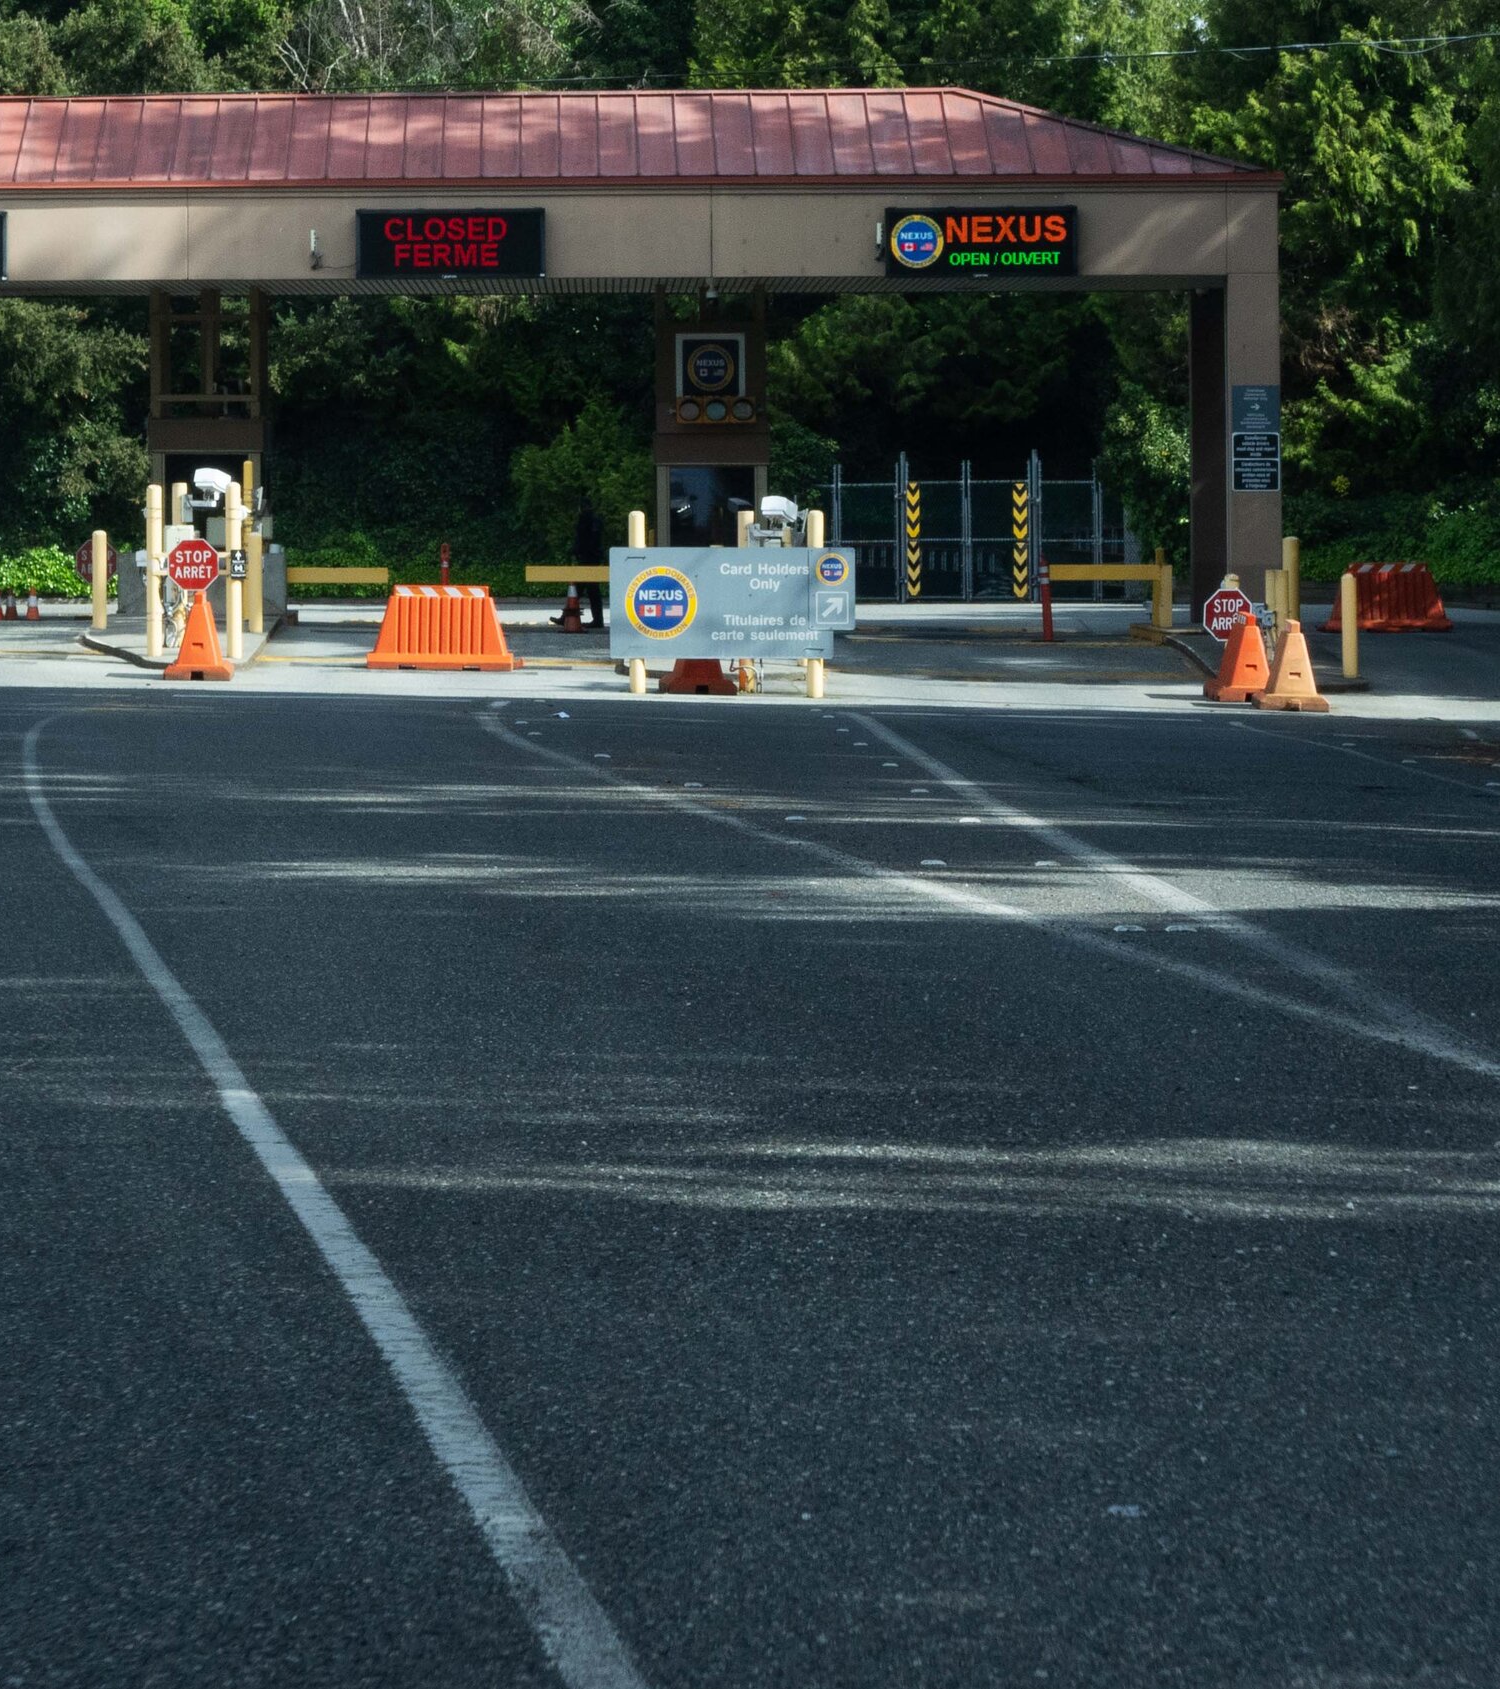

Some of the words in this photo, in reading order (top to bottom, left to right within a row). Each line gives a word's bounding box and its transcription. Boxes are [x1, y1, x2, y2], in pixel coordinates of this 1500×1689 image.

[384, 217, 508, 241] CLOSED
[945, 215, 1067, 243] NEXUS
[900, 231, 933, 240] NEXUS
[949, 252, 989, 266] OPEN
[1001, 251, 1060, 265] OUVERT
[81, 550, 113, 561] SP
[175, 551, 212, 563] STOP
[81, 563, 113, 574] ART
[174, 563, 213, 579] ARRÊT
[720, 563, 752, 575] Card
[758, 563, 809, 575] Holders
[749, 578, 780, 592] Only
[639, 589, 684, 601] NEXUS
[1213, 599, 1244, 613] STOP
[723, 614, 784, 626] Titulaires
[790, 614, 806, 626] de
[711, 630, 745, 641] carte
[750, 629, 819, 641] seulement
